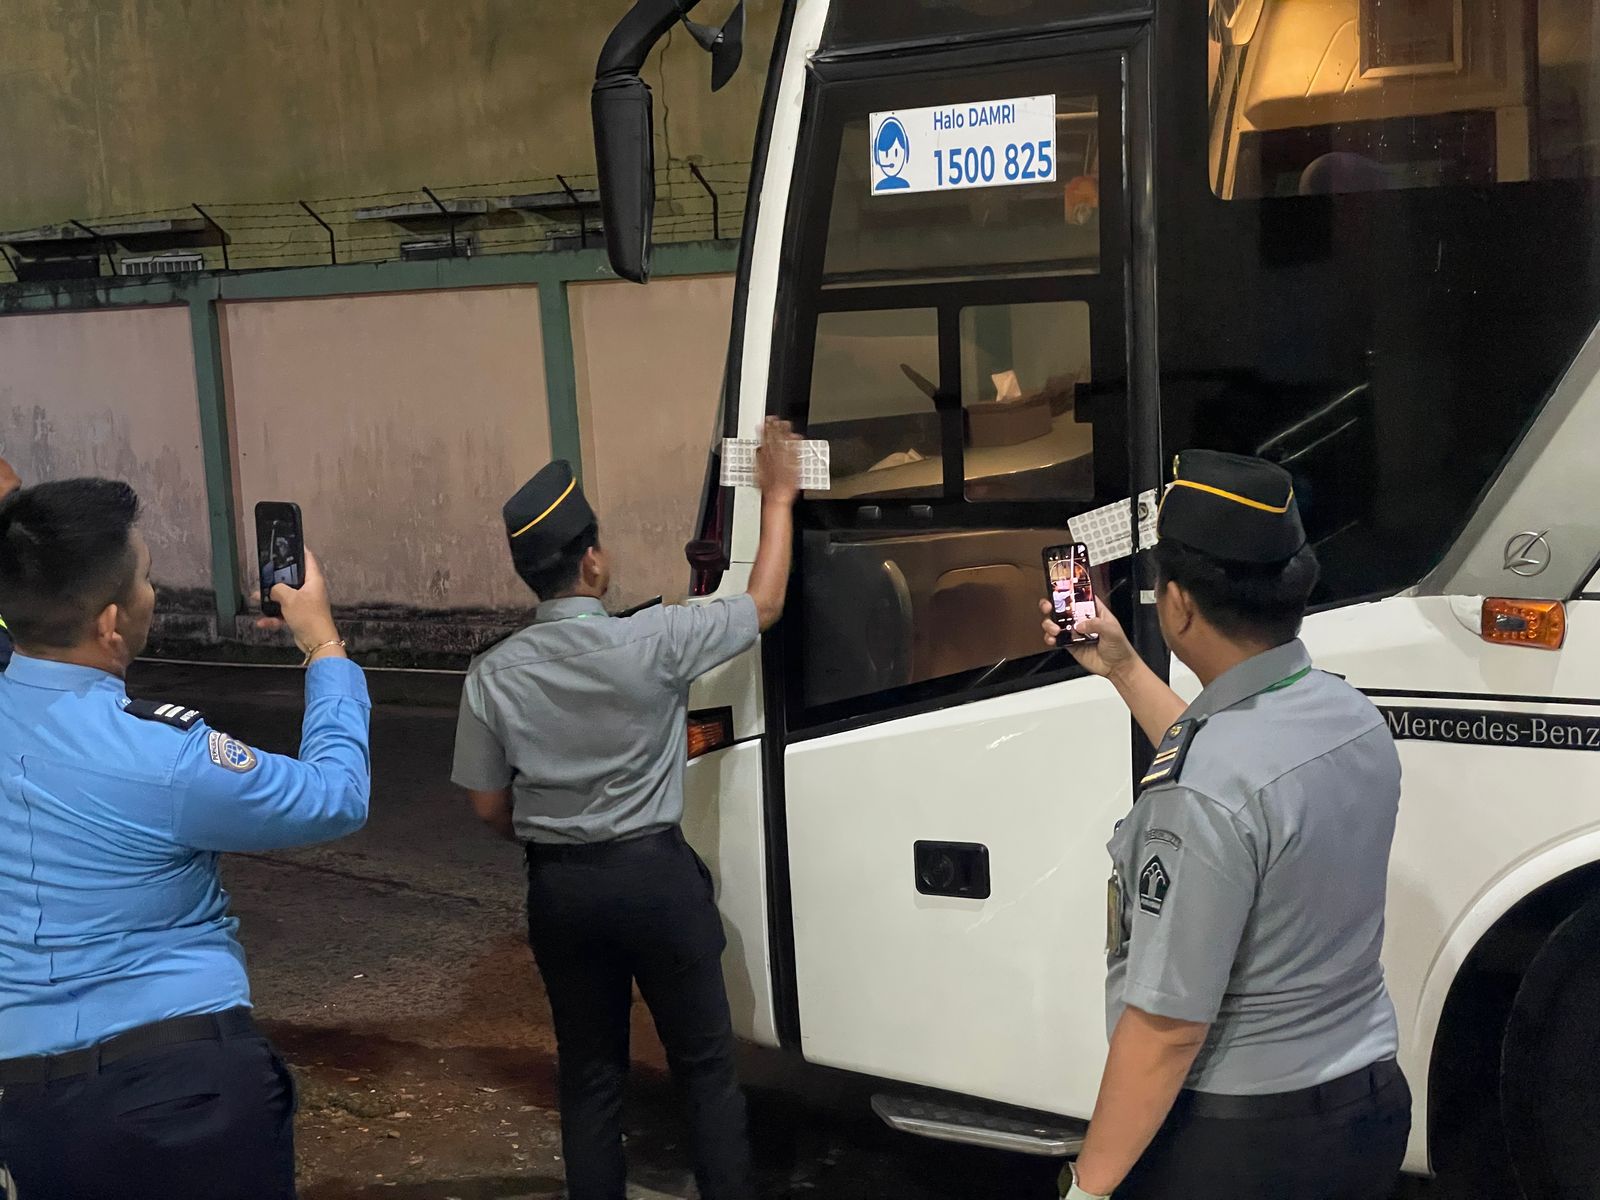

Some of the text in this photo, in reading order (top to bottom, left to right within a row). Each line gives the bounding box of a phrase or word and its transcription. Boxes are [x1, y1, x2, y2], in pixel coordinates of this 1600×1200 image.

[933, 104, 1015, 130] Halo DAMRI
[934, 140, 1052, 186] 1500 825
[1387, 710, 1600, 747] Mercedes-Benz
